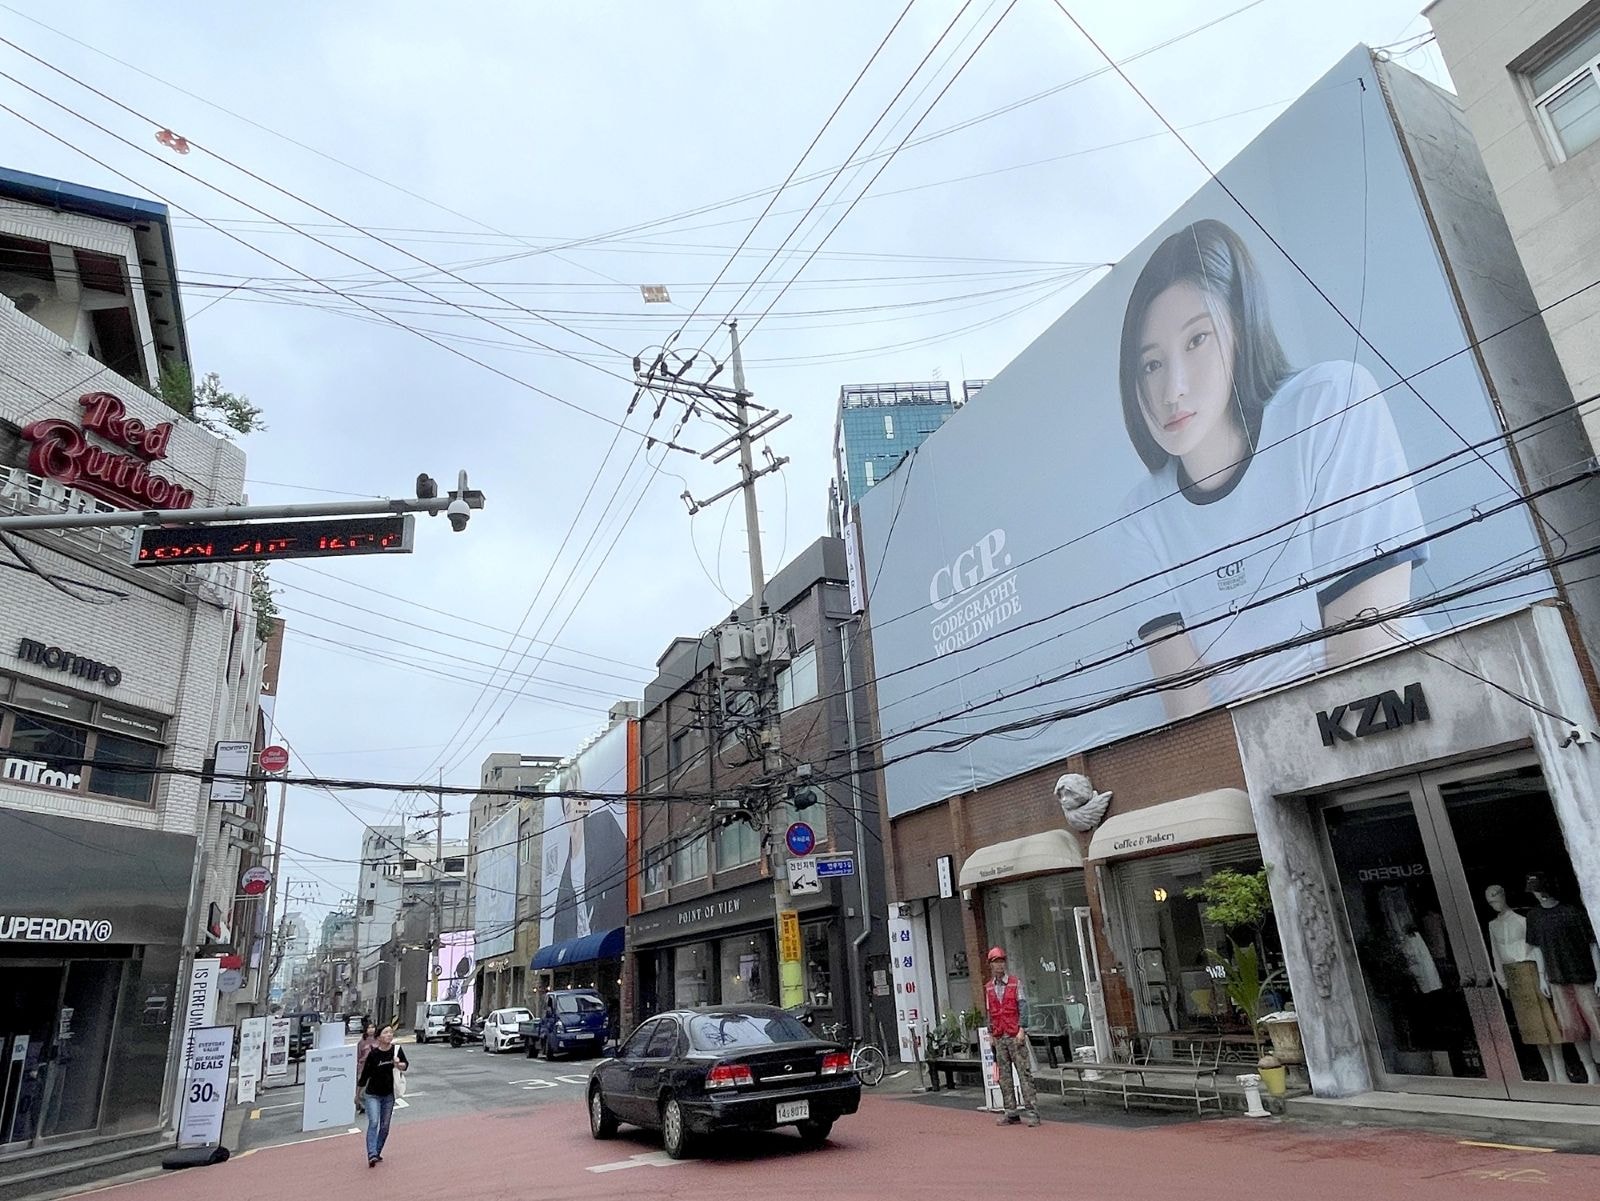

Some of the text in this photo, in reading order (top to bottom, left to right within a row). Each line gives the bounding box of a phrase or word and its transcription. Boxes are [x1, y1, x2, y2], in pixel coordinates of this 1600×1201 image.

[79, 391, 174, 460] Red
[21, 418, 195, 510] Button
[929, 528, 1012, 611] CGP.
[931, 574, 1019, 642] CODEGRAPHY
[933, 594, 1023, 658] WORLDWIDE
[18, 637, 122, 687] mormro
[1316, 682, 1430, 747] KZM
[1113, 838, 1138, 850] Coffee
[1145, 832, 1175, 844] Bakery
[678, 898, 741, 925] POINT OF VIEW
[194, 967, 209, 979] IS
[194, 1060, 224, 1071] DEALS
